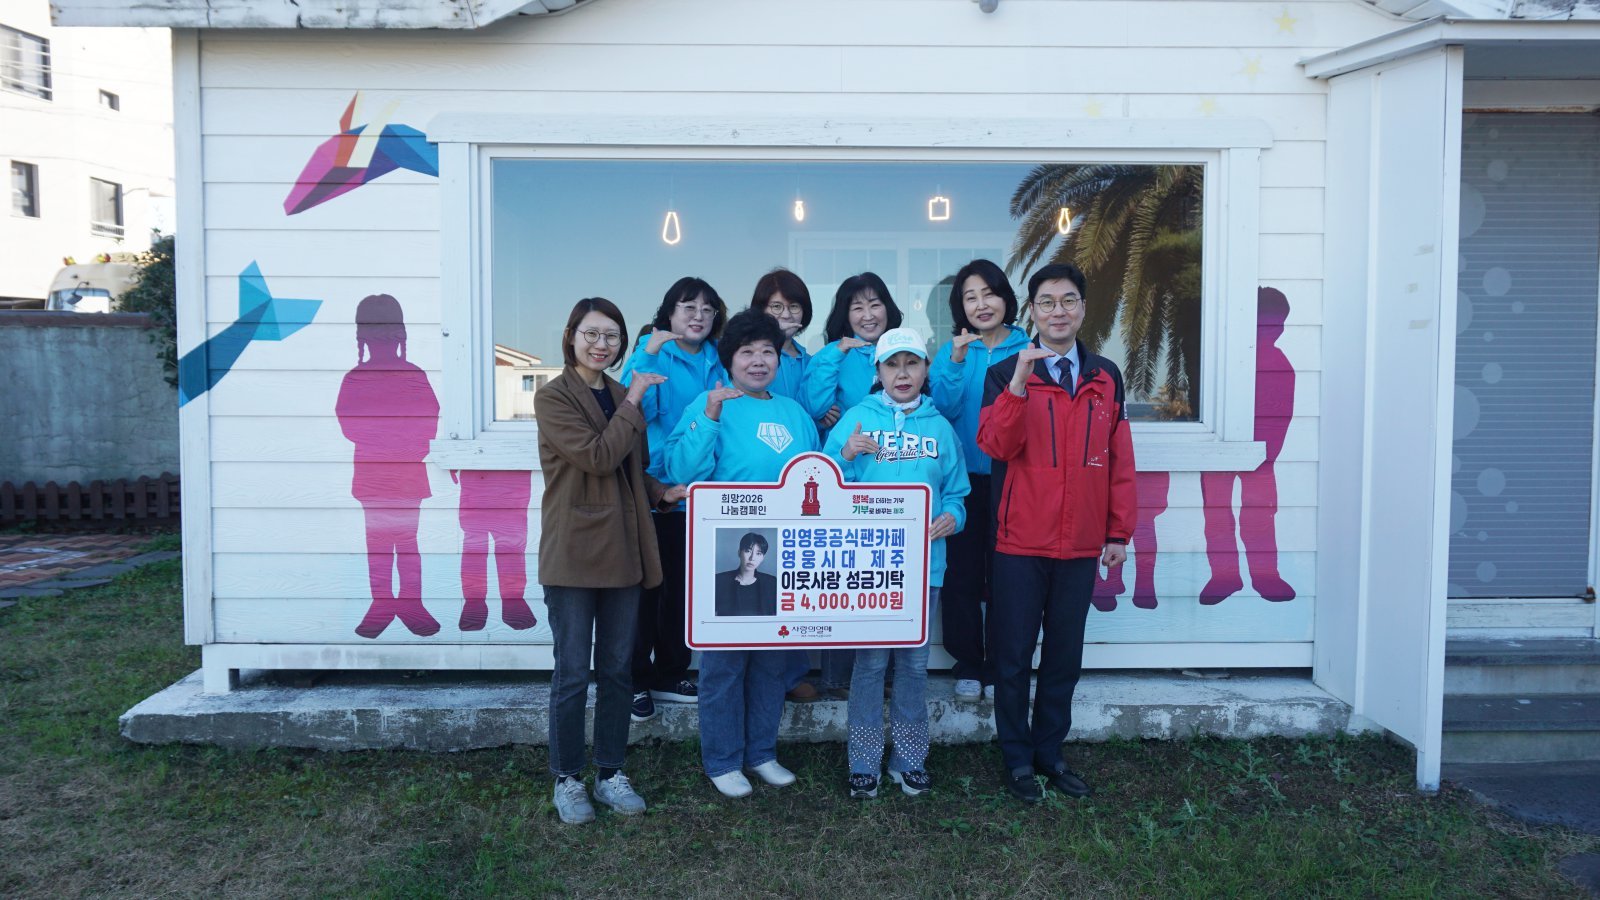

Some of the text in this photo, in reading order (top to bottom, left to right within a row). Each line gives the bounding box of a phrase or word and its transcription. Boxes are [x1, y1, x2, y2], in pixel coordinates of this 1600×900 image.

[721, 493, 763, 504] 희망2026
[721, 505, 767, 516] 나눔캠페인
[852, 505, 875, 515] 기부로
[781, 528, 905, 548] 임영웅공식팬카페
[781, 549, 905, 569] 영웅시대 제주
[781, 570, 905, 591] 이웃사랑 성금기탁
[780, 591, 904, 612] 금 4,000,000원
